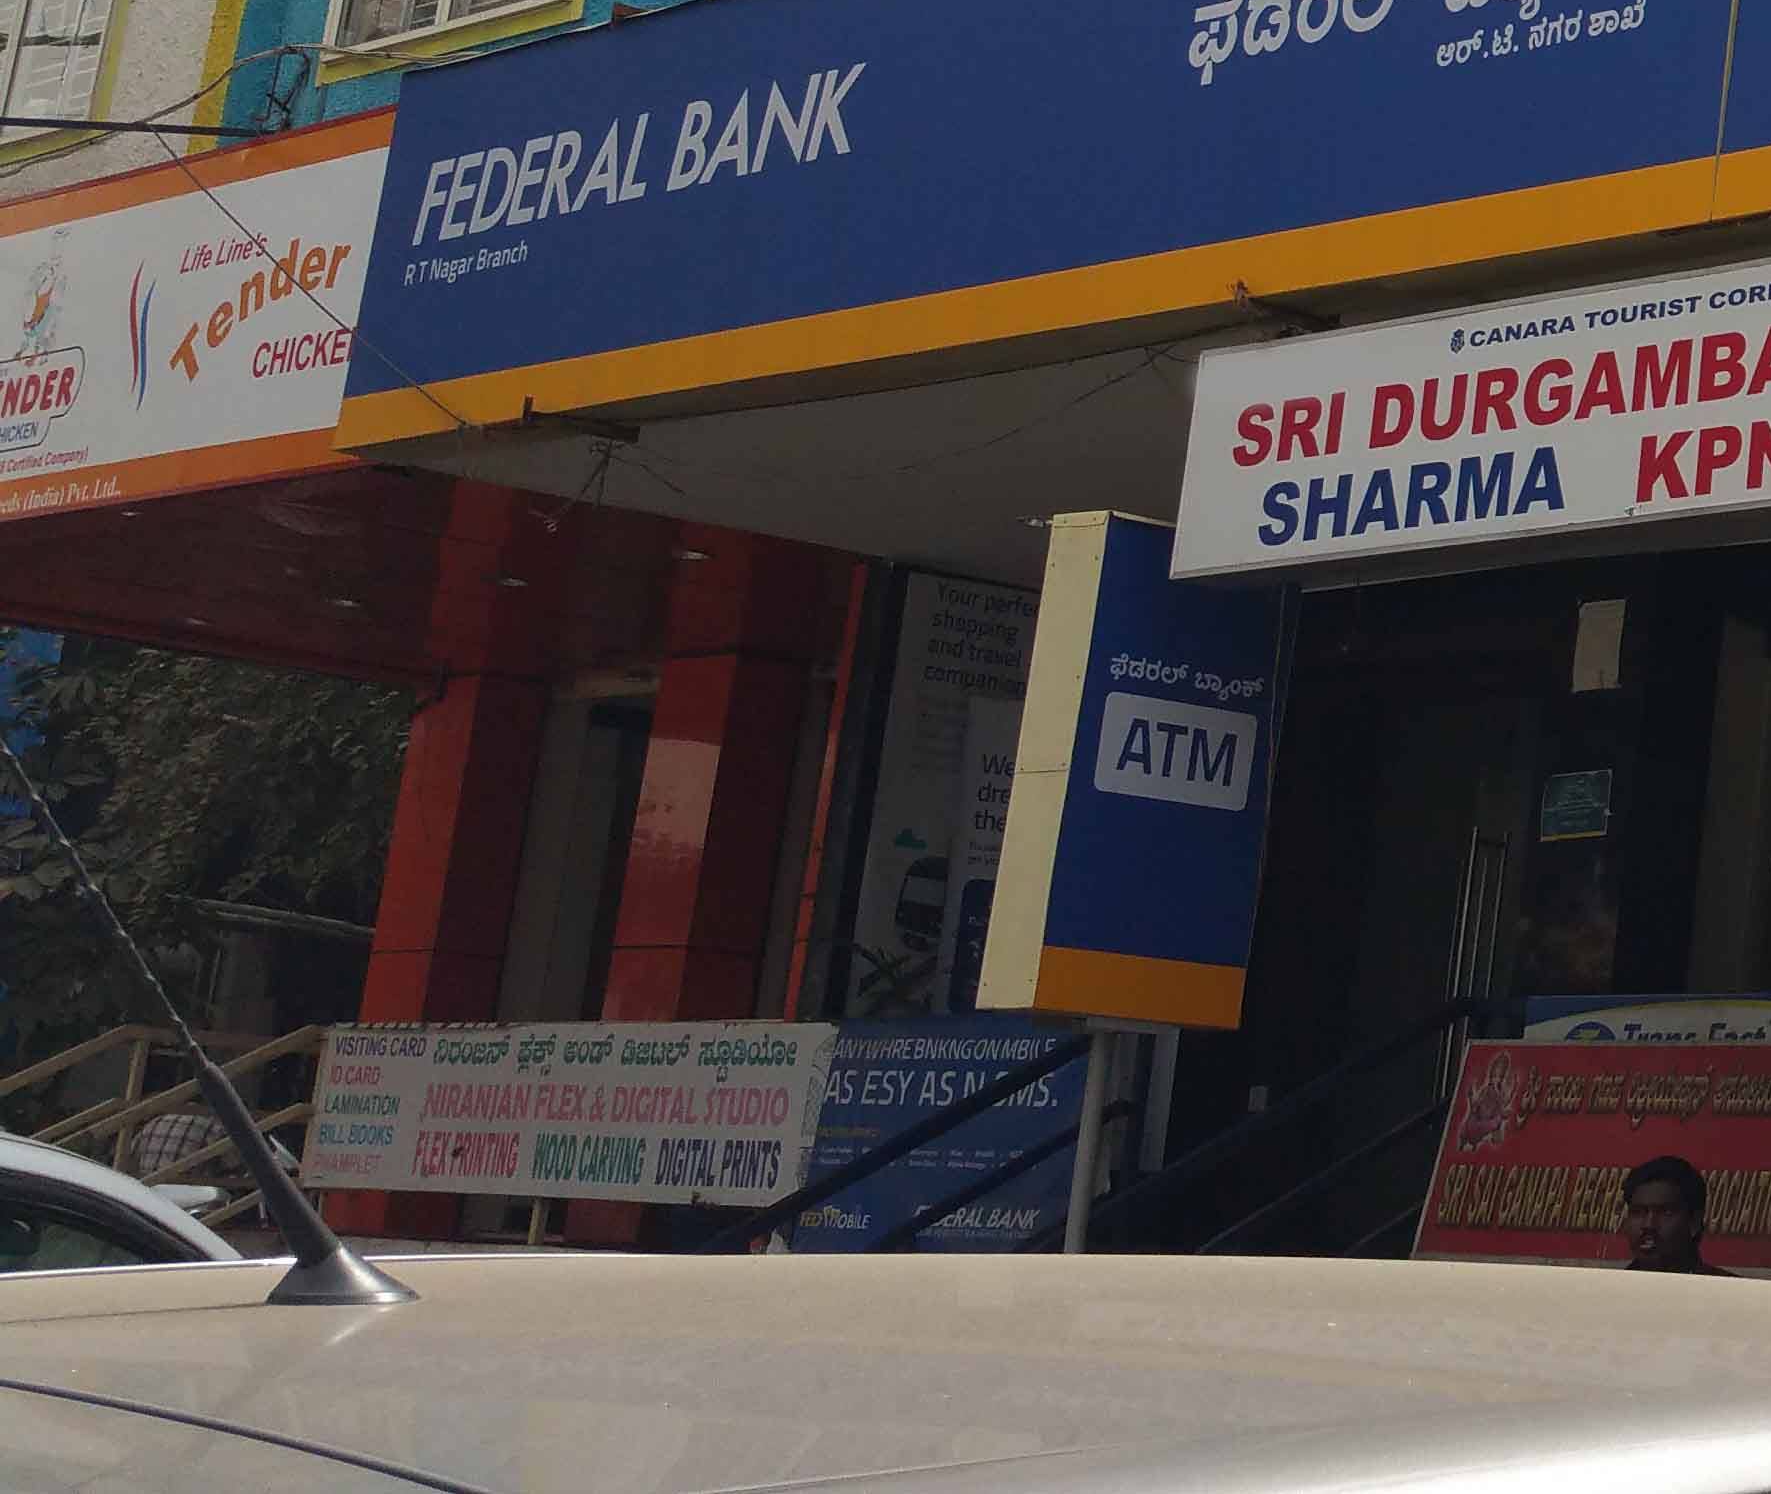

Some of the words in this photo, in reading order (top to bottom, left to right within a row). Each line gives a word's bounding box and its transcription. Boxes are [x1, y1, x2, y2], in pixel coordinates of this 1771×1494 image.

[412, 114, 650, 246] FEDERAL
[666, 62, 867, 192] BANK
[180, 244, 213, 275] Life
[430, 254, 475, 284] Nagar
[476, 239, 529, 269] Branch
[169, 238, 352, 383] Tender
[1467, 314, 1576, 350] CANARA
[1584, 295, 1701, 331] TOURIST
[1232, 390, 1345, 468] SRI
[1256, 446, 1566, 547] SHARMA
[1116, 717, 1239, 788] ATM
[335, 1036, 388, 1056] VISITING
[390, 1036, 427, 1058] CARD
[324, 1094, 401, 1117] LAMINATION
[534, 1083, 587, 1123] FLEX
[609, 1086, 699, 1127] DIGITAL
[702, 1086, 790, 1128] STUDIO
[862, 1071, 915, 1107] ESY
[917, 1071, 956, 1107] AS
[411, 1130, 450, 1178] FLEX
[531, 1134, 575, 1185] WOOD
[576, 1136, 648, 1187] CARVING
[655, 1139, 718, 1188] DIGITAL
[720, 1140, 782, 1190] PRINTS
